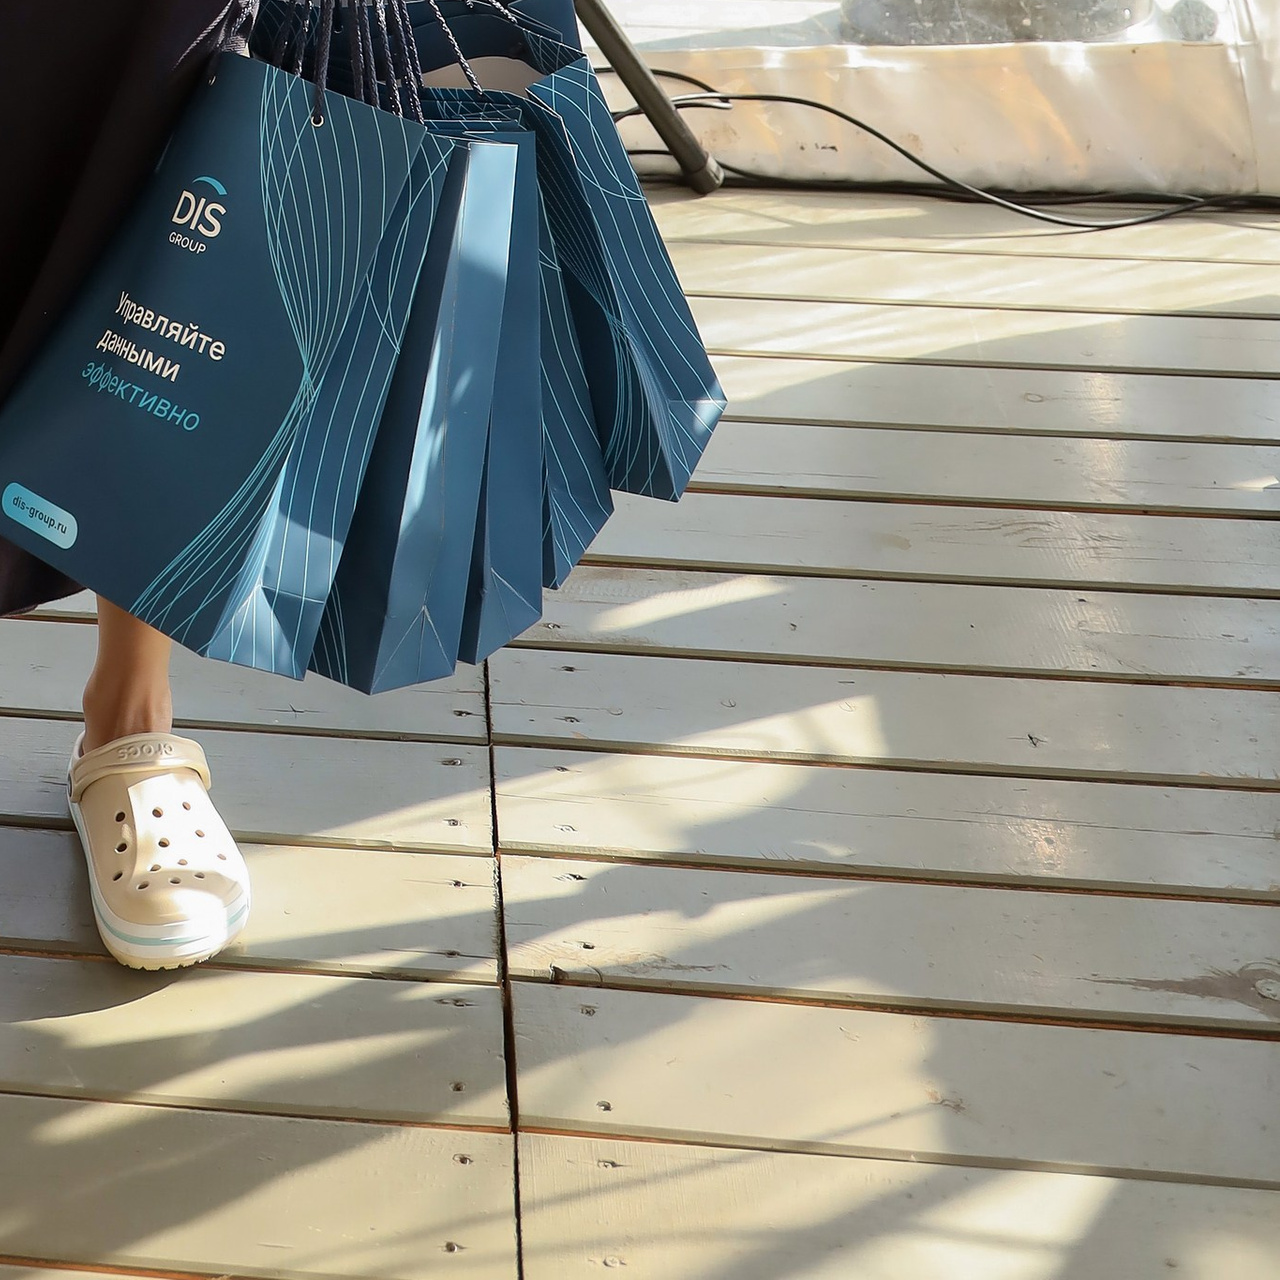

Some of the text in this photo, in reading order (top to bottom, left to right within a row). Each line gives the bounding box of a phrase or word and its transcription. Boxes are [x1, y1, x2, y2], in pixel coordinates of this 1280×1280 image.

[171, 189, 227, 238] DIS
[168, 231, 207, 255] GROUP
[115, 290, 226, 361] Управляйте
[96, 329, 181, 383] данными
[81, 362, 200, 431] эффективно
[12, 495, 68, 535] dis-group.ru
[117, 742, 175, 761] crocs
